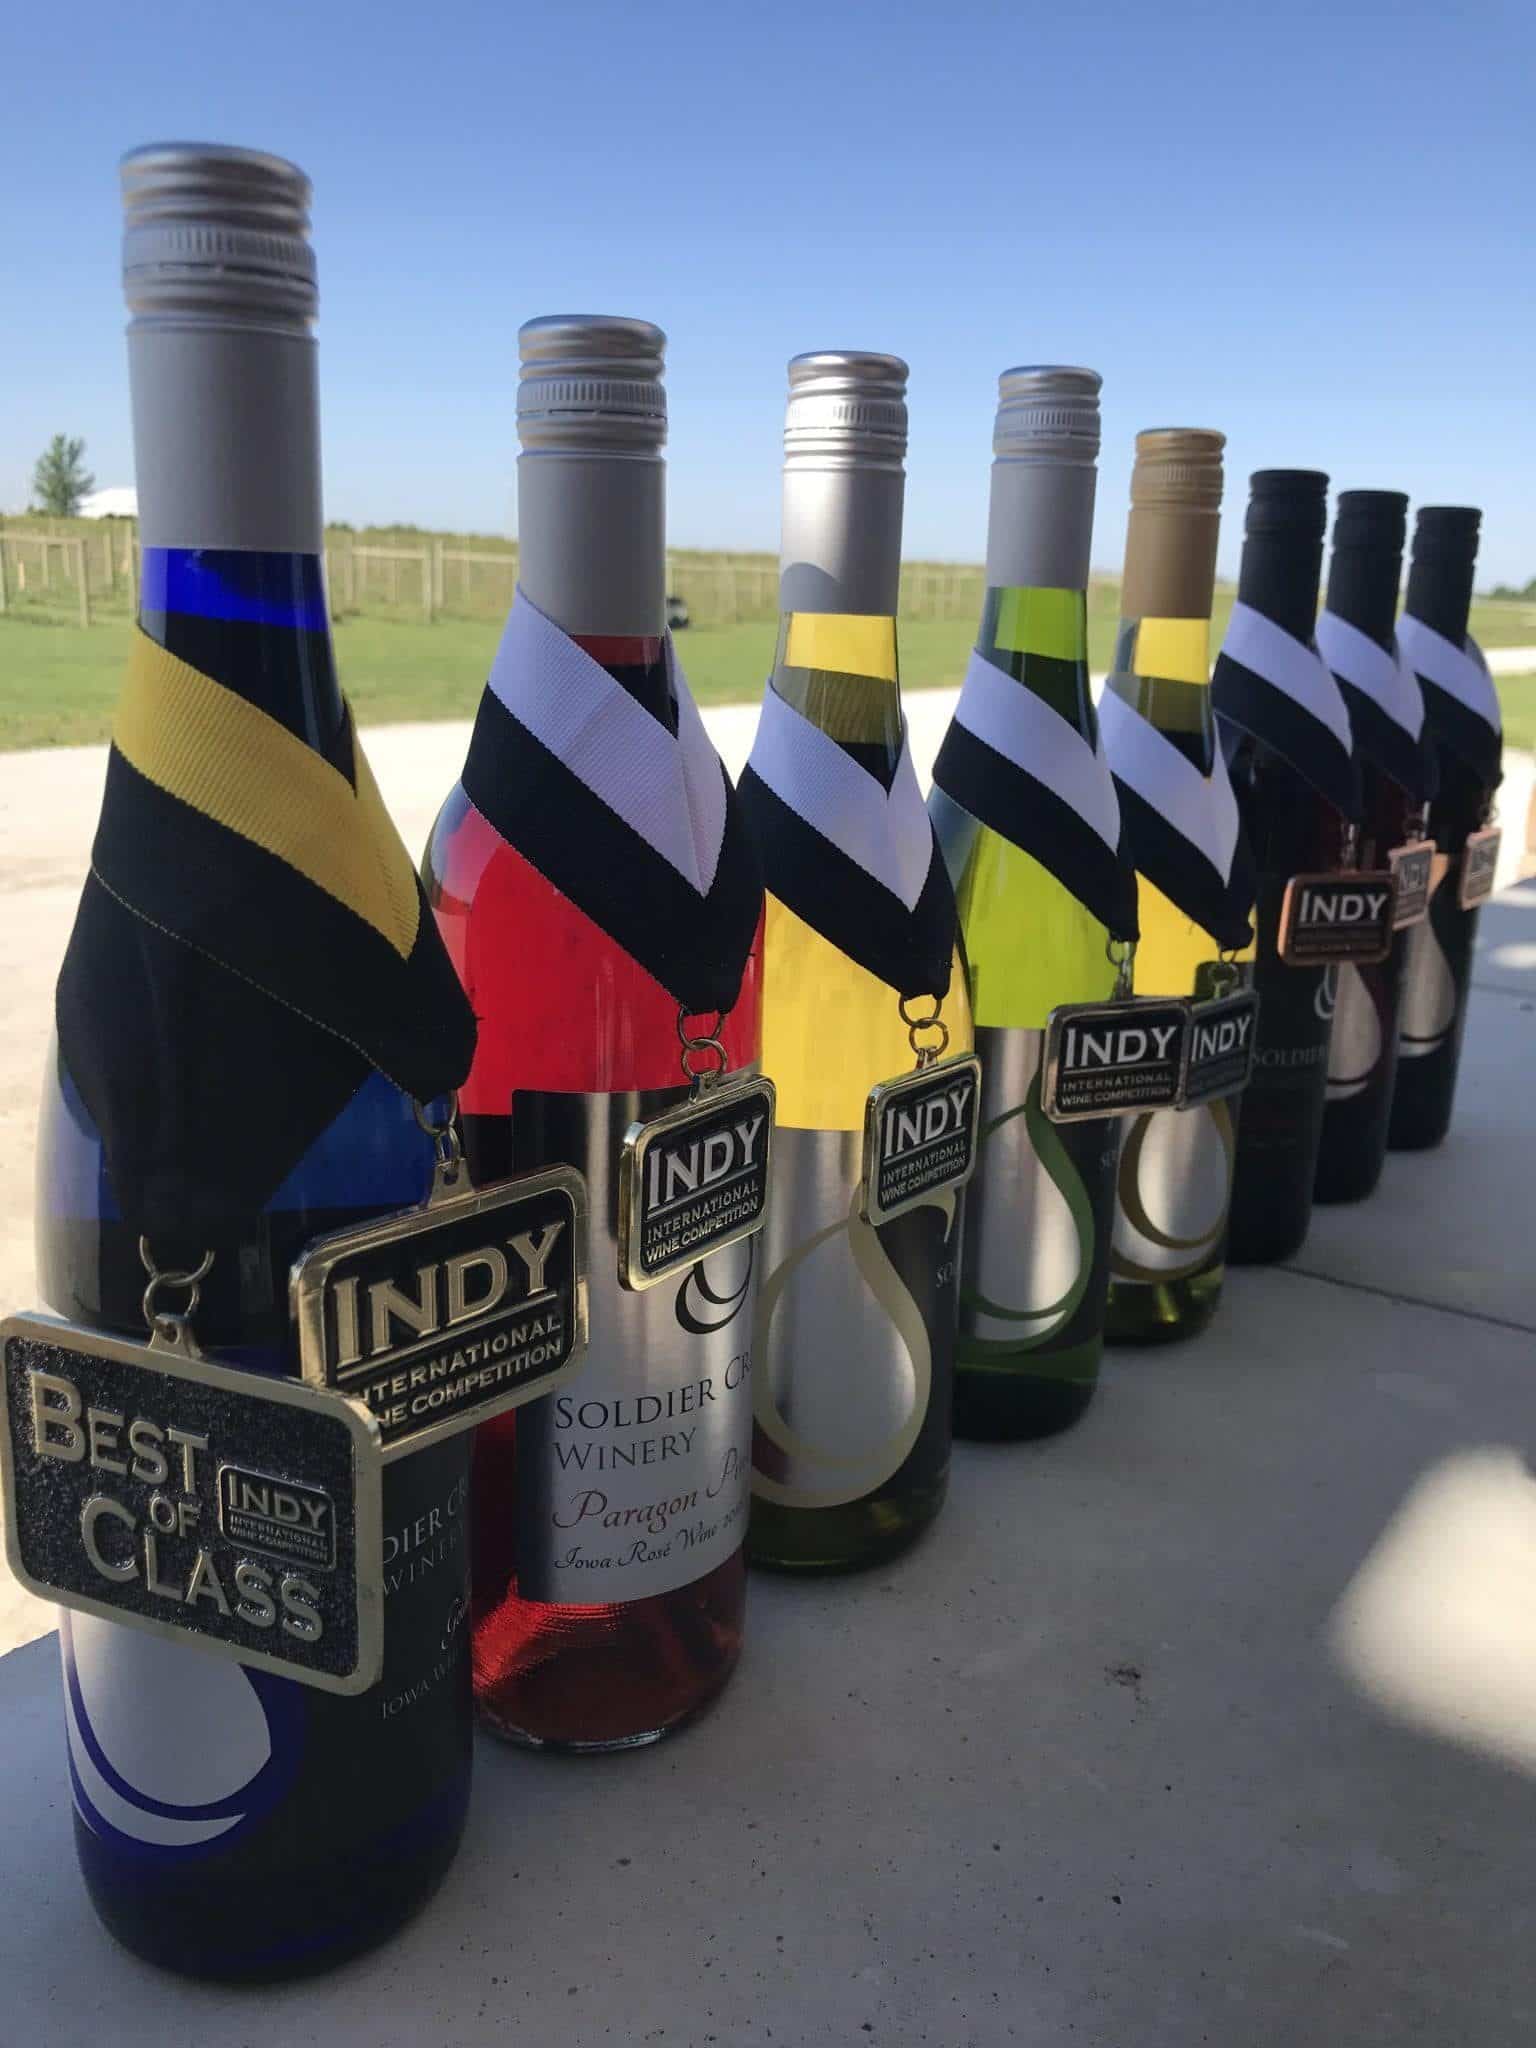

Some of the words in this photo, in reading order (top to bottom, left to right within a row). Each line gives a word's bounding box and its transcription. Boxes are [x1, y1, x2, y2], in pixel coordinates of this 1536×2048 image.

[1301, 890, 1387, 922] INDY
[1065, 1026, 1177, 1068] INDY
[1191, 1014, 1251, 1062] INDY
[1061, 1093, 1090, 1106] WINE
[1063, 1071, 1171, 1092] INTERNATIONAL
[883, 1086, 971, 1160] INDY
[646, 1114, 765, 1211] INDY
[881, 1181, 907, 1205] WINE
[908, 1152, 968, 1191] COMPETITION
[882, 1140, 966, 1185] INTERNATIONAL
[646, 1235, 680, 1263] WINE
[681, 1196, 759, 1246] COMPETITION
[647, 1179, 759, 1244] INTERNATIONAL
[334, 1221, 566, 1369] INDY
[411, 1340, 561, 1414] COMPETITION
[555, 1378, 716, 1430] SOLDIER
[31, 1371, 209, 1494] BEST
[553, 1427, 697, 1471] WINERY
[150, 1495, 203, 1537] OF
[228, 1471, 328, 1529] INDY
[552, 1489, 698, 1534] Paragon
[81, 1496, 323, 1641] CLASS
[554, 1546, 612, 1569] Iowa
[675, 1520, 718, 1551] Wine
